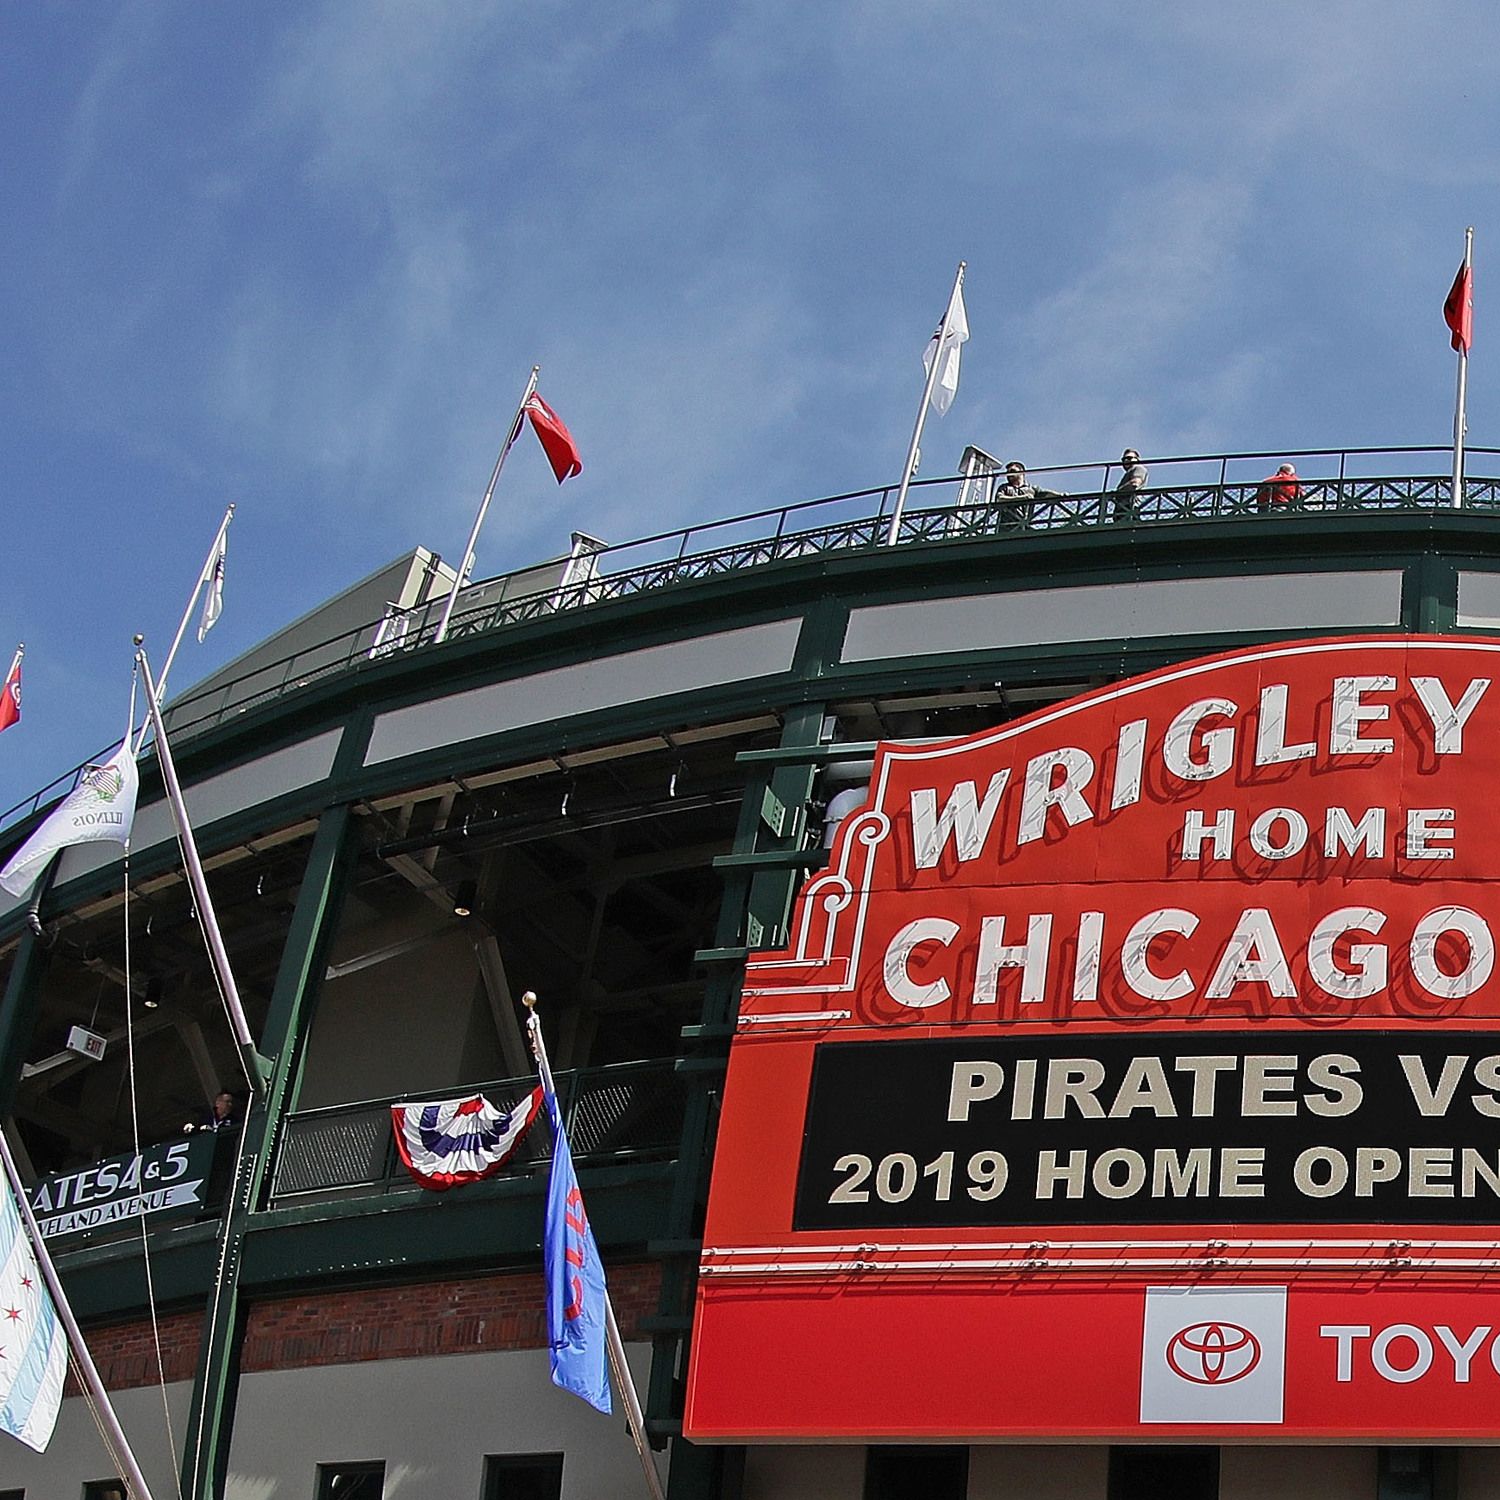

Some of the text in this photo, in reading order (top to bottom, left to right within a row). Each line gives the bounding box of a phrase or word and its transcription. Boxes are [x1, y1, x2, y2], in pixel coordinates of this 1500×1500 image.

[910, 675, 1492, 870] WRIGLEY
[1180, 807, 1456, 860] HOME
[883, 905, 1495, 1009] CHICAGO
[946, 1053, 1364, 1122] PIRATES
[106, 1189, 173, 1220] AVENUE
[827, 1150, 1009, 1204] 2019
[1034, 1147, 1266, 1200] HOME
